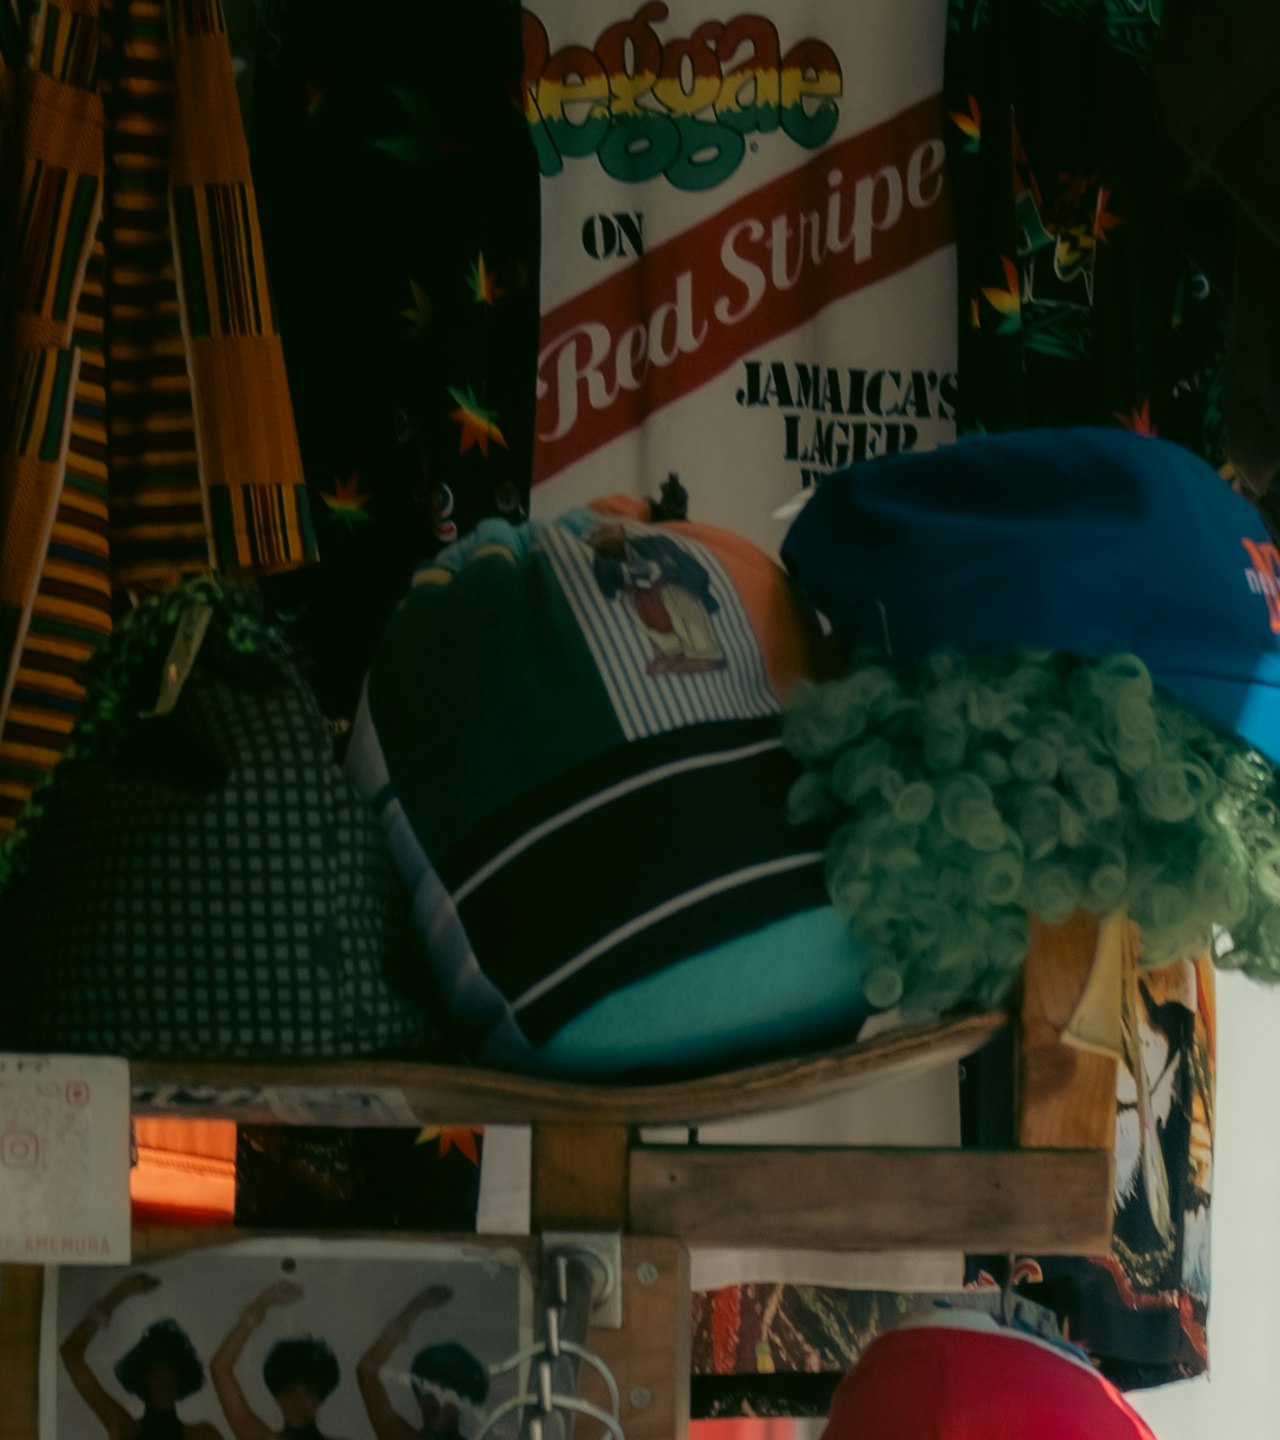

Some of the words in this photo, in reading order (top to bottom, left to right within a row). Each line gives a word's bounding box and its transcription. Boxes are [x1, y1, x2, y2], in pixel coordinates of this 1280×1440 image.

[582, 212, 645, 260] ON
[536, 269, 708, 443] Red
[714, 138, 946, 326] Stripe
[736, 360, 960, 421] JAMAICA'S
